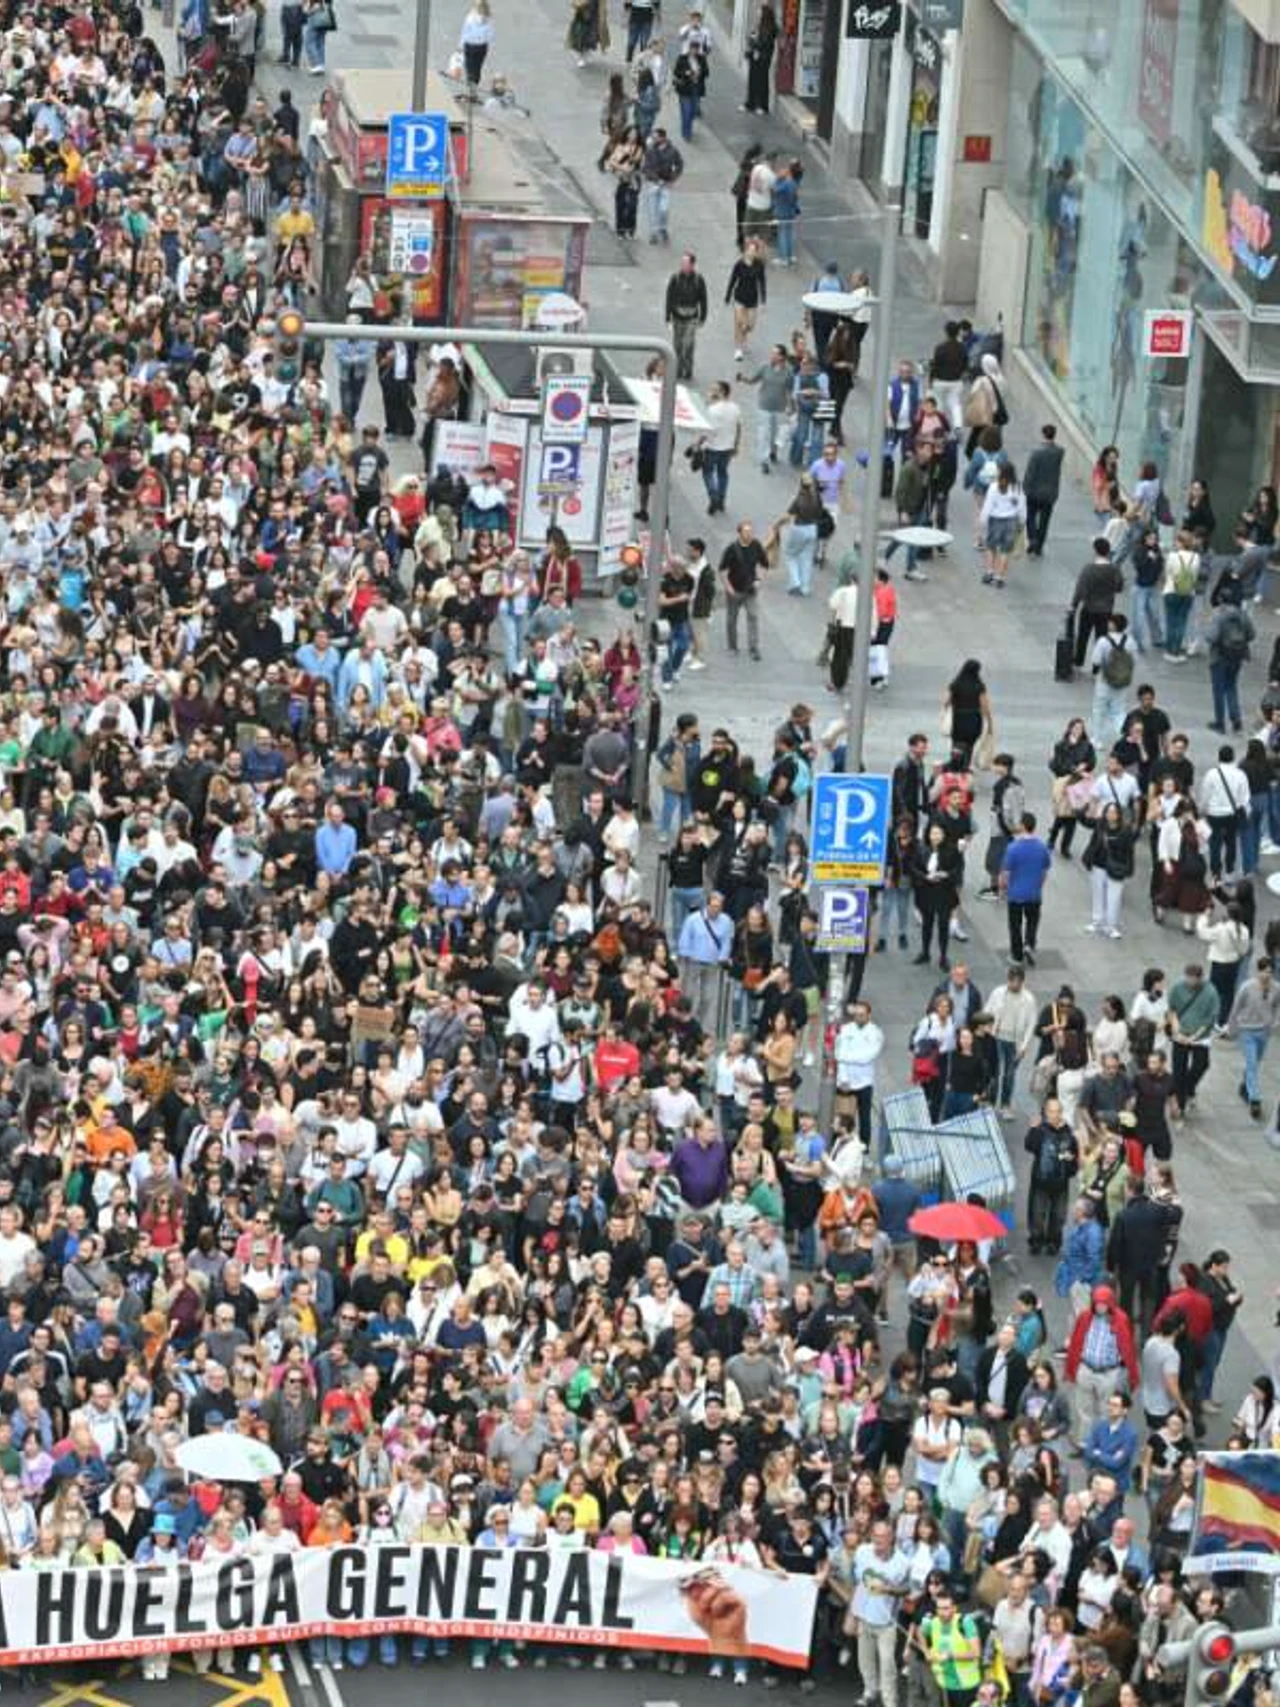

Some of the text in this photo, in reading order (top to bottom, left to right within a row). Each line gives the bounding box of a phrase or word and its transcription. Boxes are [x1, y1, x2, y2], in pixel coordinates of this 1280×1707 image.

[401, 124, 437, 172] P
[827, 788, 877, 850] P
[821, 891, 858, 935] P
[36, 1552, 300, 1645] HUELGA
[326, 1547, 633, 1629] GENERAL
[19, 1640, 169, 1663] EXPROPIACIÓN
[177, 1632, 258, 1648] FONDOS
[267, 1623, 338, 1641] BUITRE
[359, 1619, 475, 1636] CONTRATOS
[484, 1625, 618, 1643] INDEFINIDOS
